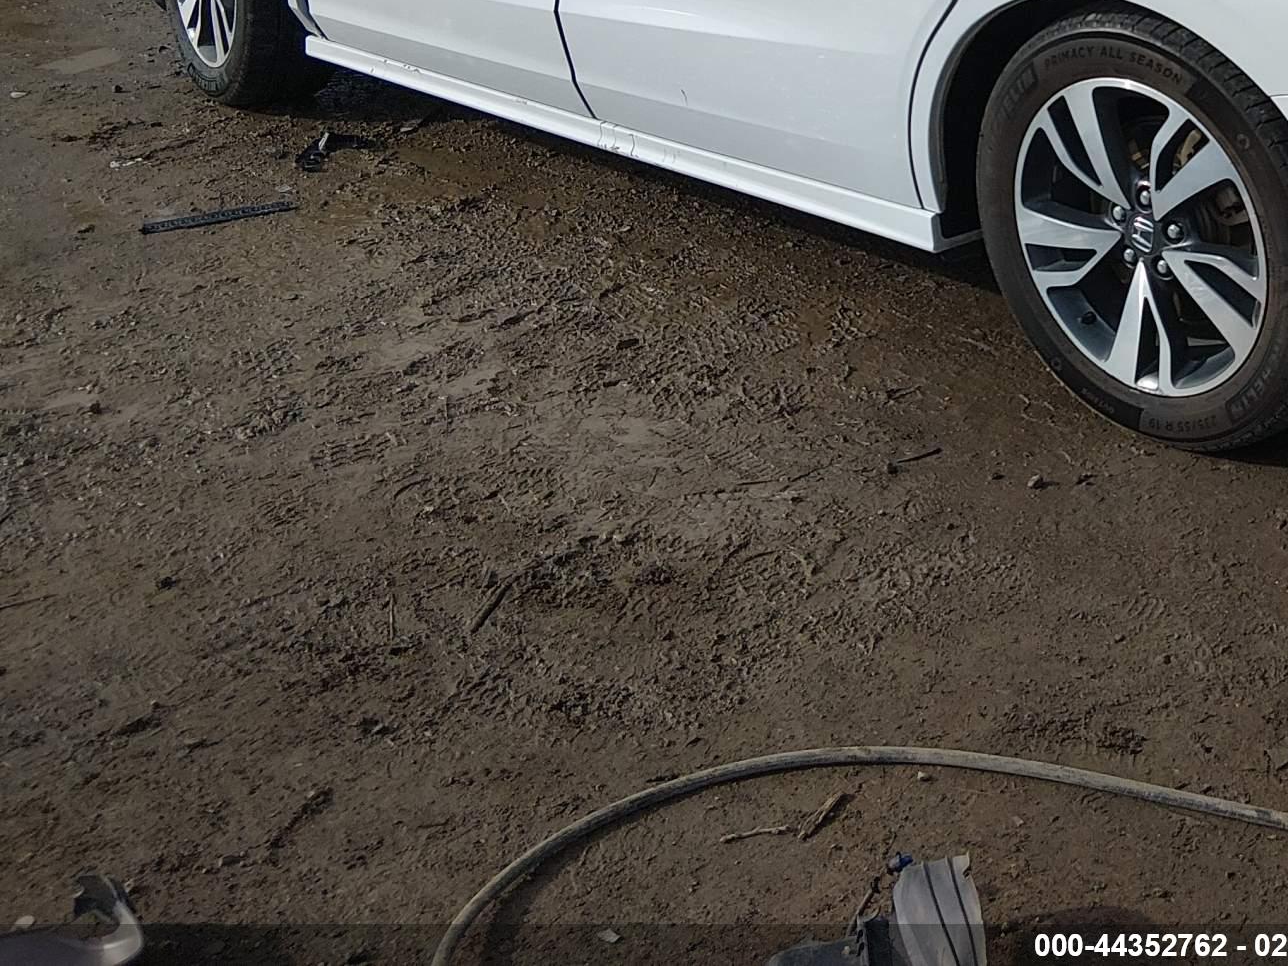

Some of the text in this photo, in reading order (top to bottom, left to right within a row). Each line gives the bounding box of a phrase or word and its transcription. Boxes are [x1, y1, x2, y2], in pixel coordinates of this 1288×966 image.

[1044, 45, 1183, 85] PRIMACY ALL SEASON
